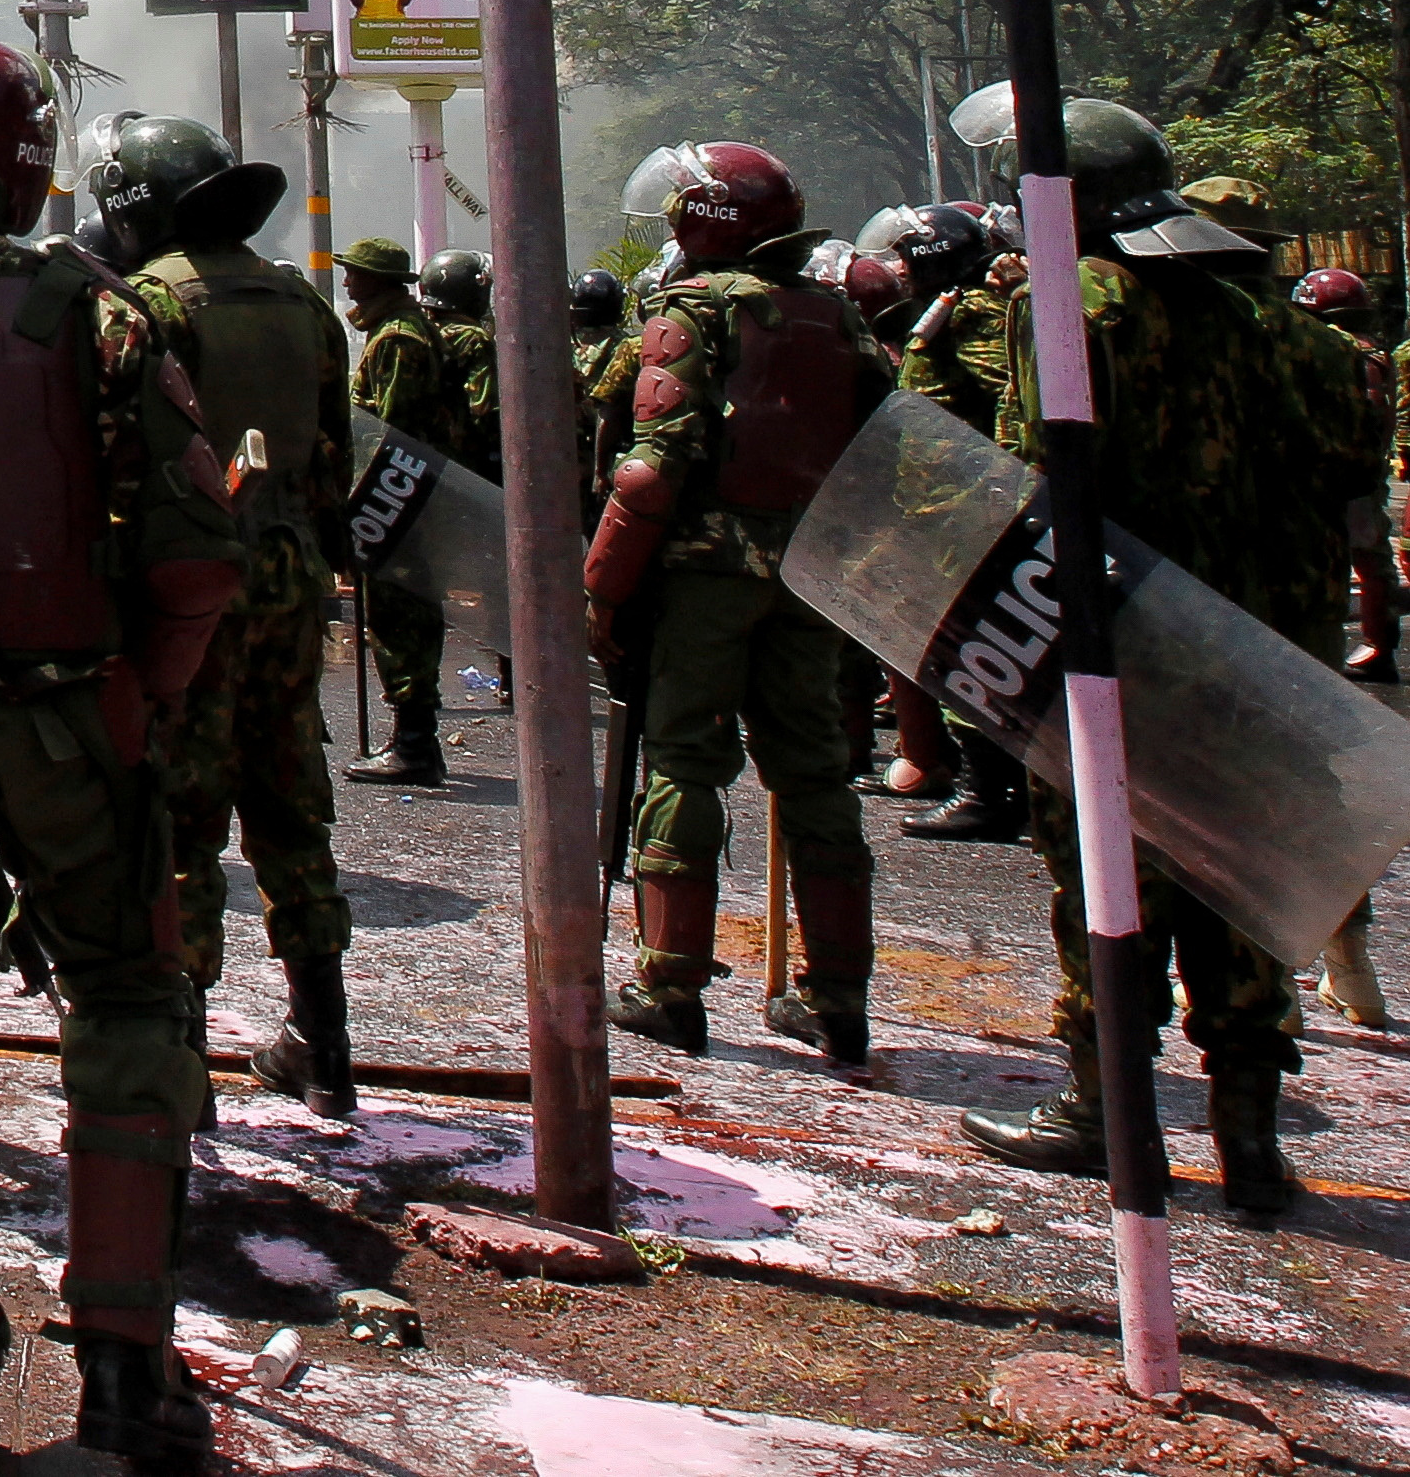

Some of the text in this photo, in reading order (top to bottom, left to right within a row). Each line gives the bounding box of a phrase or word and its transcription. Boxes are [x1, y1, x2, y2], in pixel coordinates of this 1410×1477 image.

[391, 35, 444, 45] Apply Now
[105, 183, 151, 212] POLICE
[444, 172, 486, 218] ALL WAY
[687, 201, 739, 221] POLICE
[911, 240, 951, 258] POLICE
[945, 526, 1116, 726] POLIC
